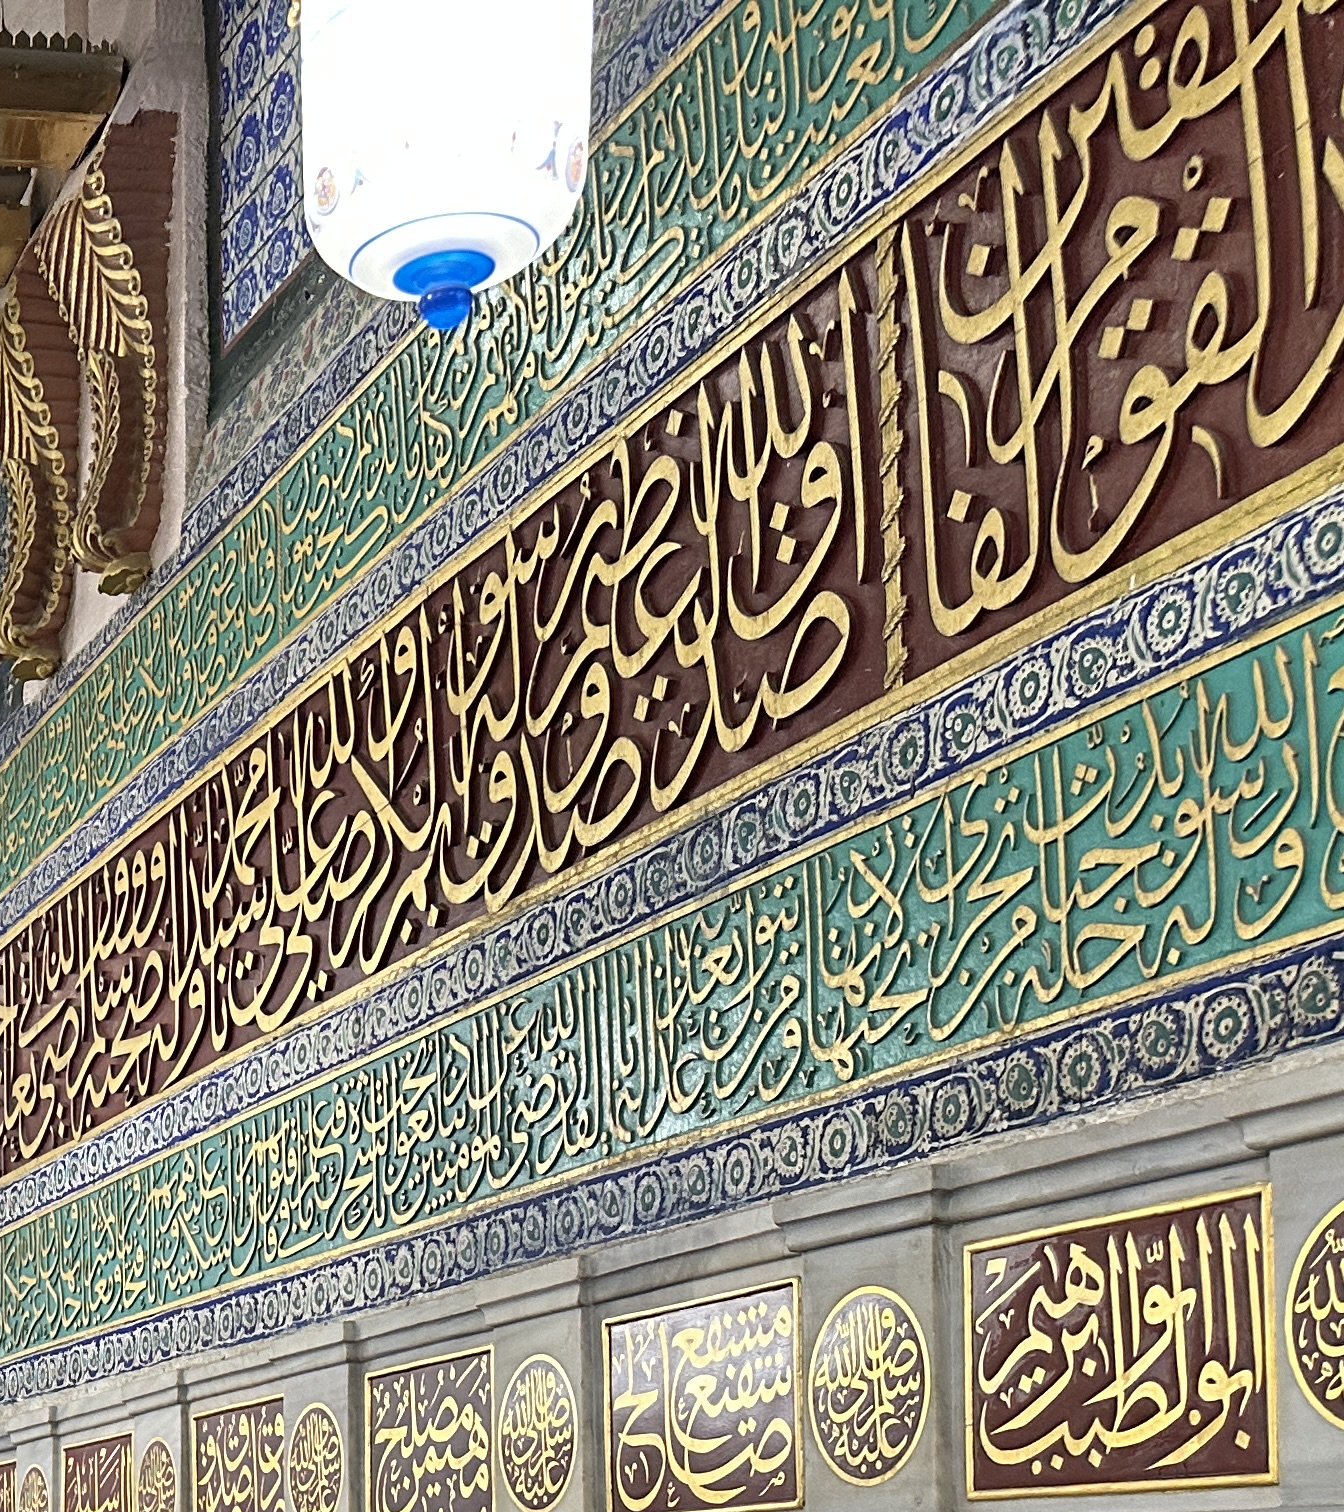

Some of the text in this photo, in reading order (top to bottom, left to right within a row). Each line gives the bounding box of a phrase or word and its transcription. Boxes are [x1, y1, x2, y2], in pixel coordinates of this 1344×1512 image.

[525, 346, 758, 738] العظيم
[690, 266, 865, 583] الله
[1194, 631, 1319, 829] الله
